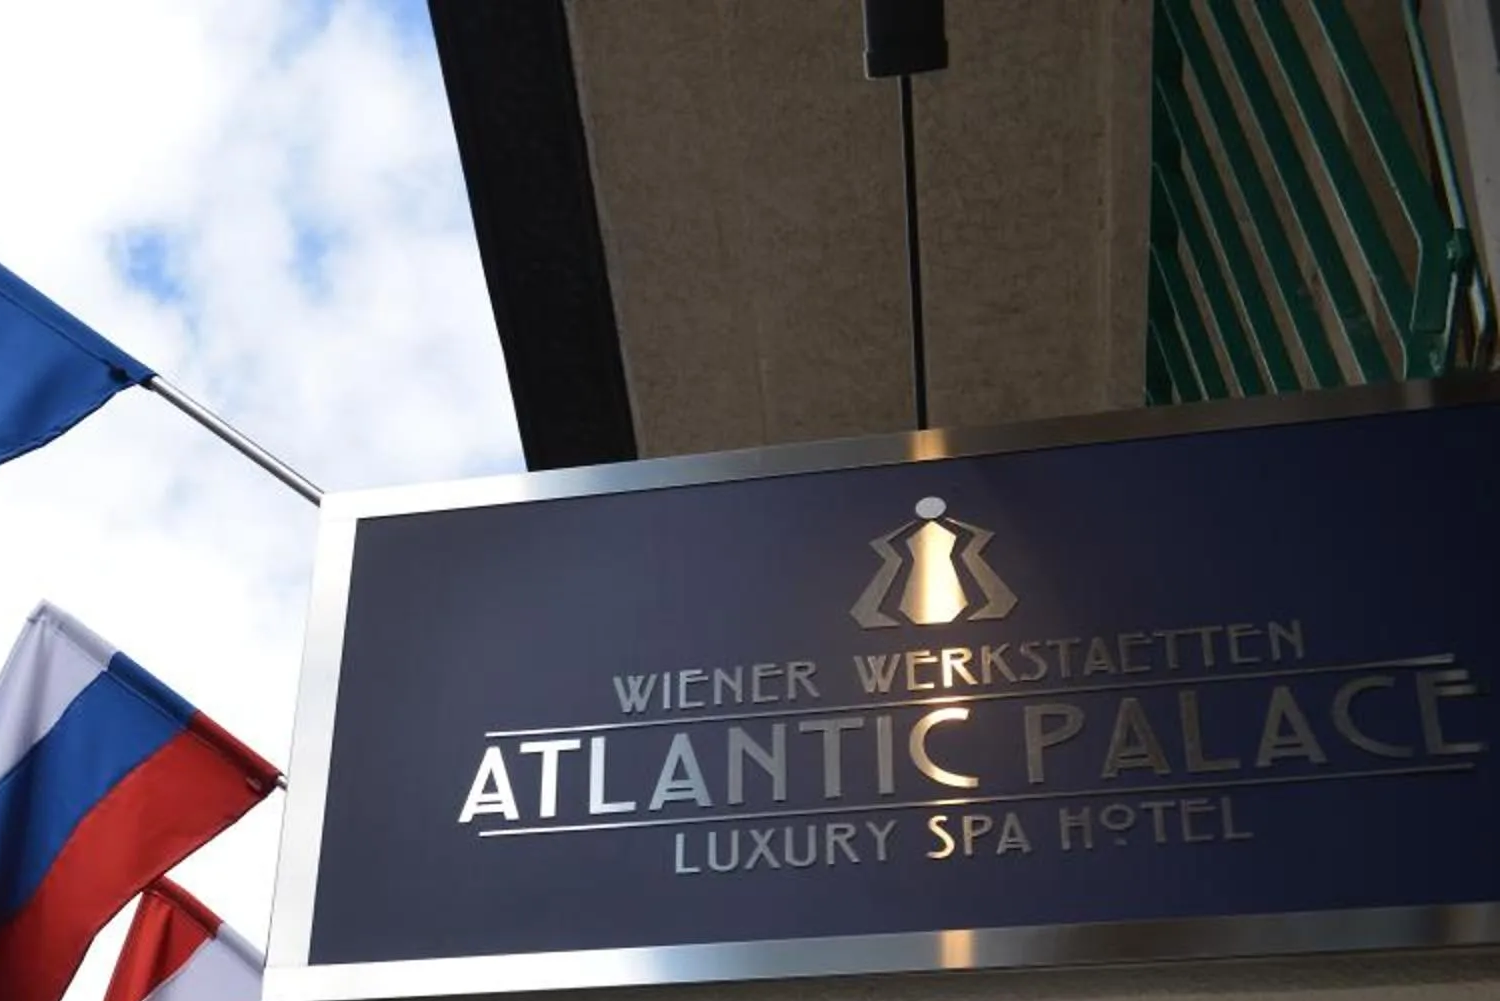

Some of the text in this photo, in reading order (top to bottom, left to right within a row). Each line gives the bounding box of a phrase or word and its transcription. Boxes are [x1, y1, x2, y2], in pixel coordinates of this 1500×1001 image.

[612, 619, 1306, 714] WIENER WERKSTAETTEN
[457, 668, 1488, 823] ATLANTIC PALACE
[674, 818, 898, 875] LUXURY
[926, 811, 1034, 861] SPA
